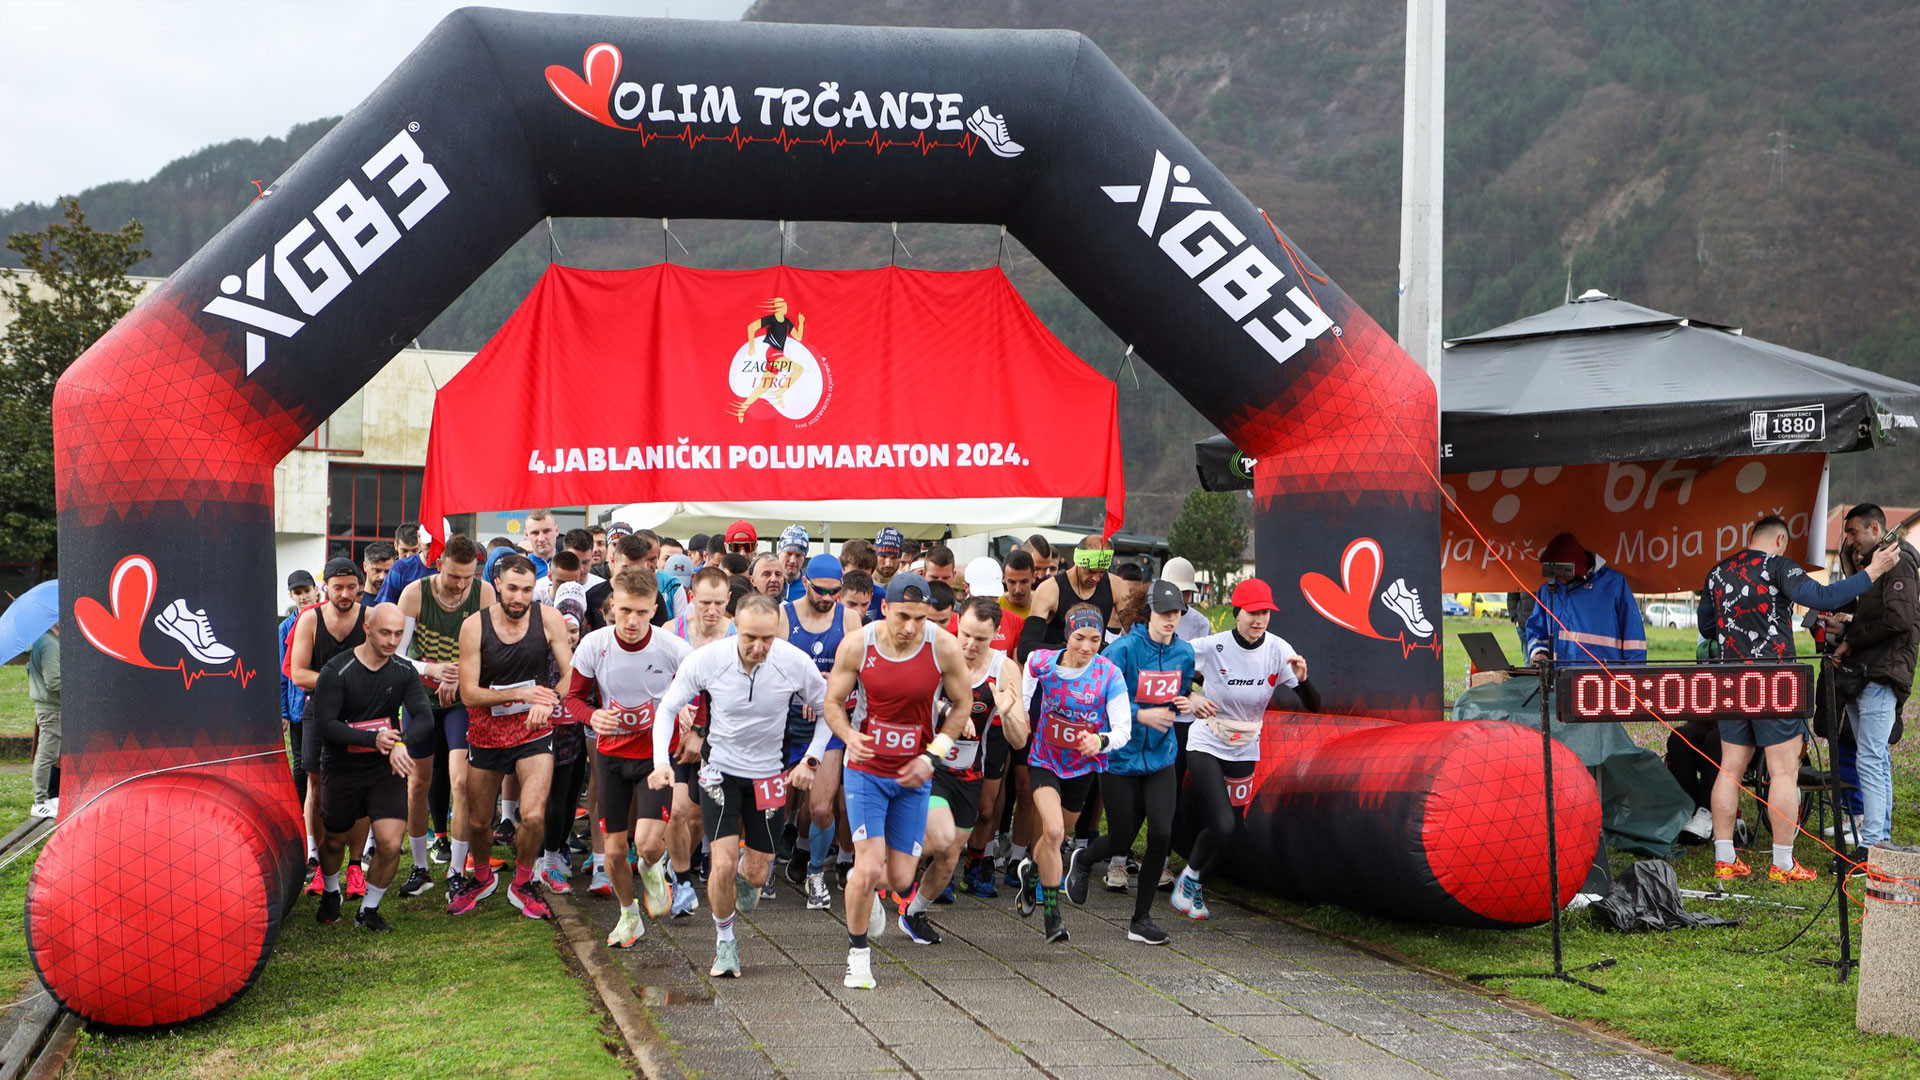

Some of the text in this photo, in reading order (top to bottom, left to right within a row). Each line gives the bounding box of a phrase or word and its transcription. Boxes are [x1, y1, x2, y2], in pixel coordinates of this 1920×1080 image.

[753, 81, 964, 131] TRČANJE
[761, 374, 792, 388] TRČI
[1772, 417, 1816, 433] 1880
[729, 444, 950, 469] POLUMARATON
[957, 442, 1030, 466] 2024.
[1440, 531, 1474, 570] ja
[1614, 526, 1703, 569] Moja
[1143, 679, 1178, 696] 124
[1577, 671, 1798, 716] 00:00:00
[871, 728, 916, 749] 196
[1051, 723, 1076, 743] 16
[759, 776, 788, 800] 13
